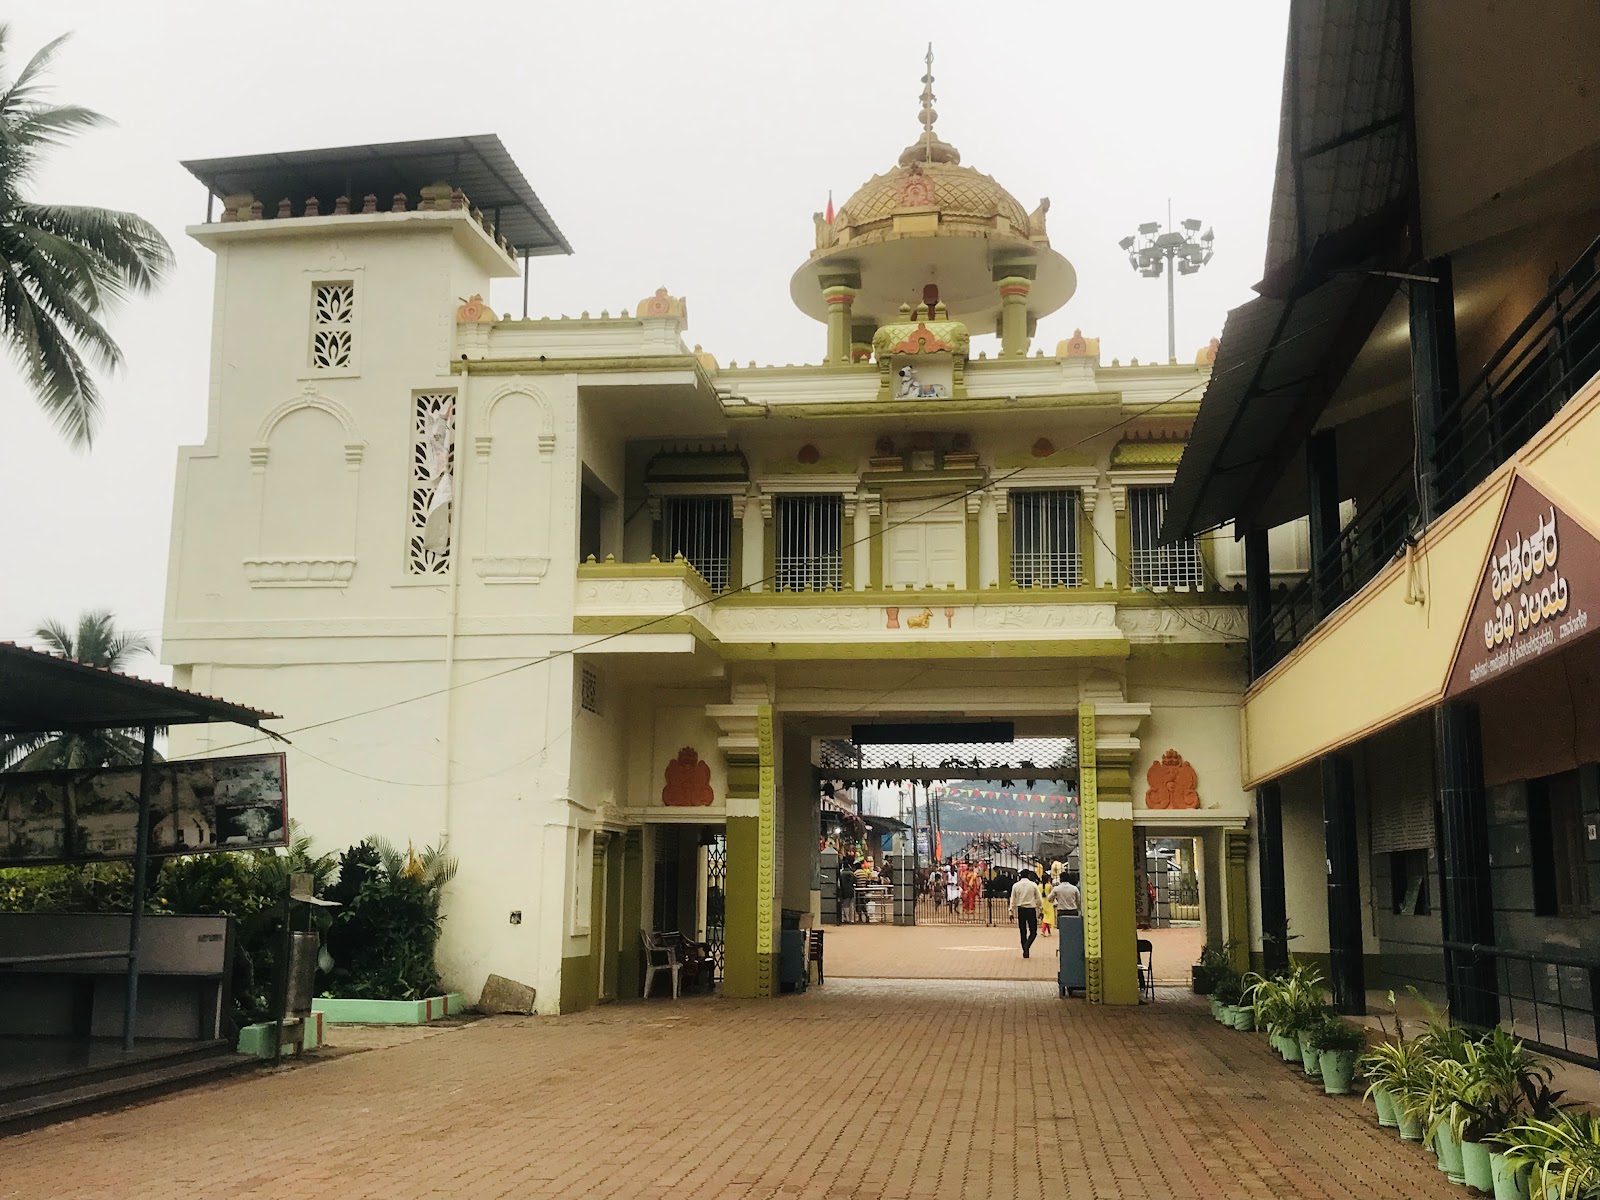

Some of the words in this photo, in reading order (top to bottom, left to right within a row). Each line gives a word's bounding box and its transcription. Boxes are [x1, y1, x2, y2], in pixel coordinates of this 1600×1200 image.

[1492, 506, 1558, 602] ಶಿವಶಂಕರ
[1485, 602, 1515, 649] ಅತಿಥಿ
[1518, 570, 1568, 633] ನಿಲಯ
